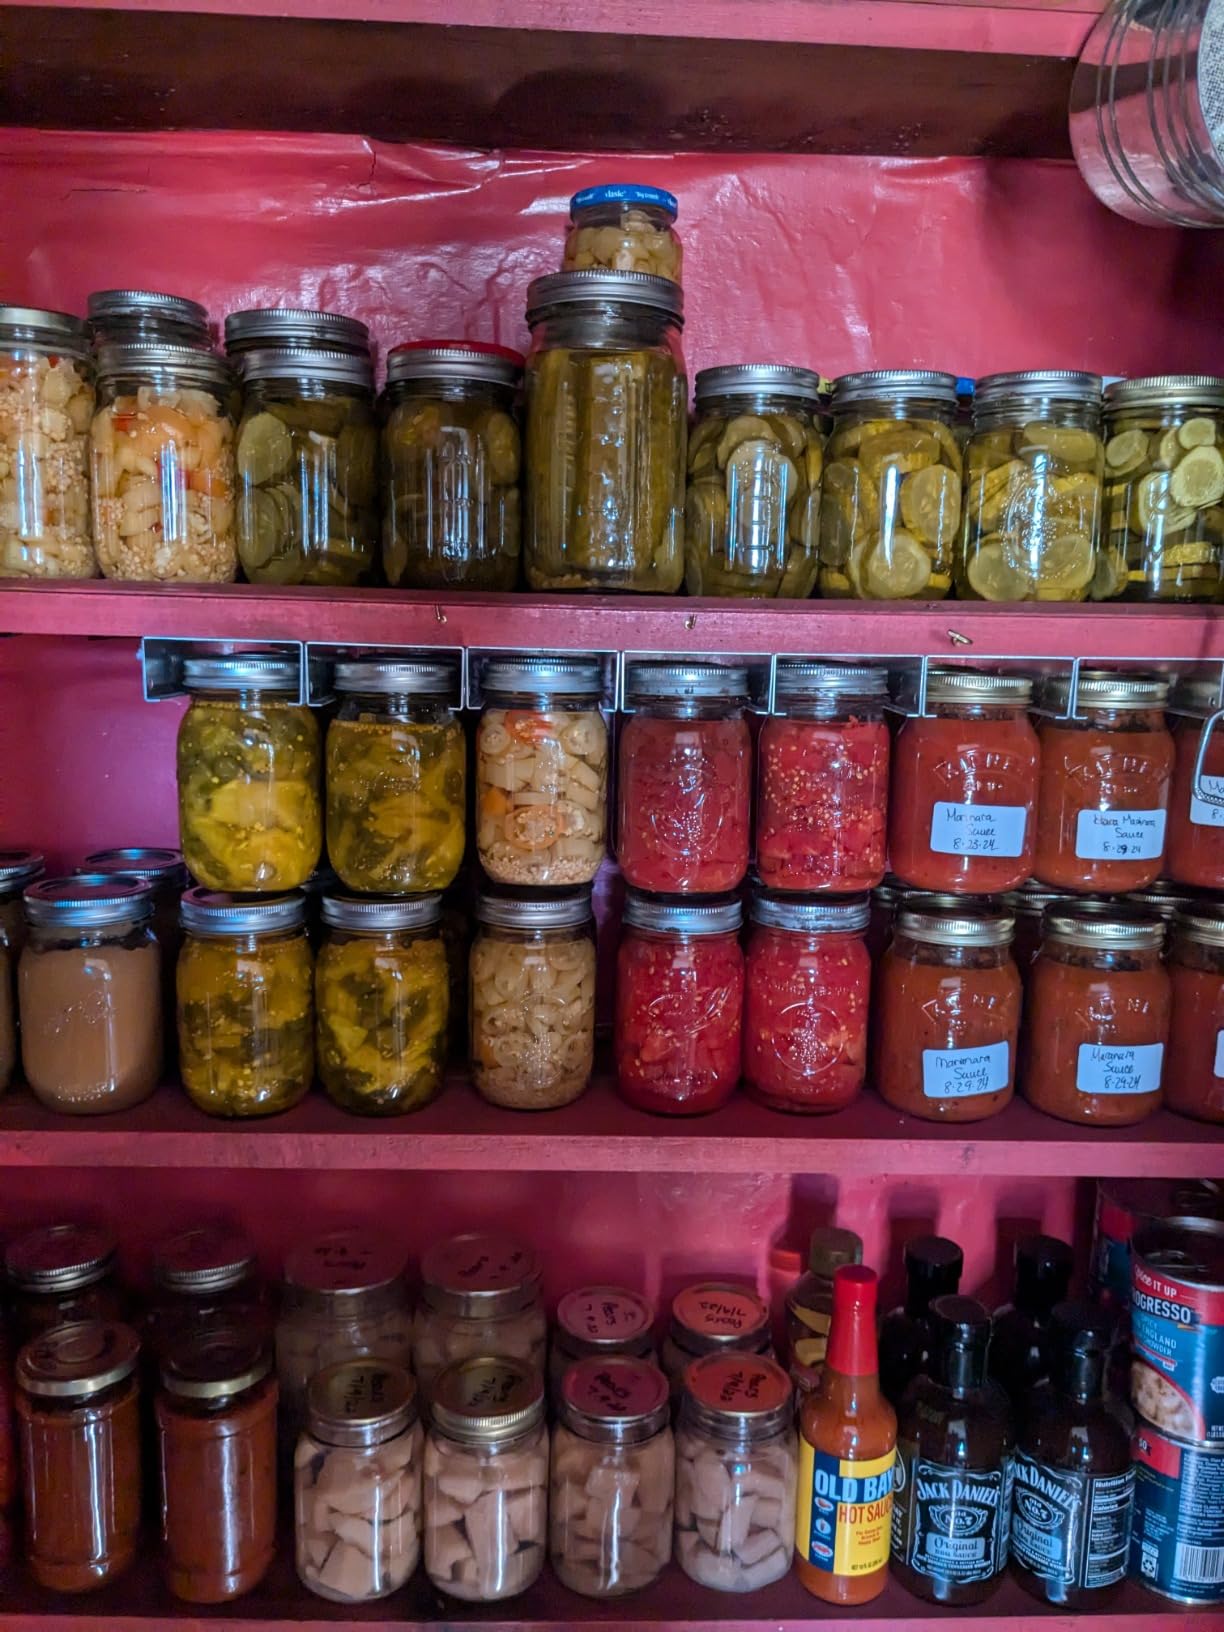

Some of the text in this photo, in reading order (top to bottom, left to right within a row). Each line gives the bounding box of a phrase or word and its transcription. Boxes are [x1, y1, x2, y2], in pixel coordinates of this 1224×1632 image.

[946, 807, 997, 822] Marnara
[953, 1067, 987, 1080] Sauce
[1103, 1061, 1134, 1074] Sauce
[1153, 1279, 1162, 1293] IT
[1164, 1284, 1177, 1299] UP
[1132, 1287, 1191, 1324] OGRESSO
[814, 1467, 894, 1502] OLD BAY
[916, 1478, 951, 1501] JACK
[838, 1494, 893, 1525] HOT SAUC
